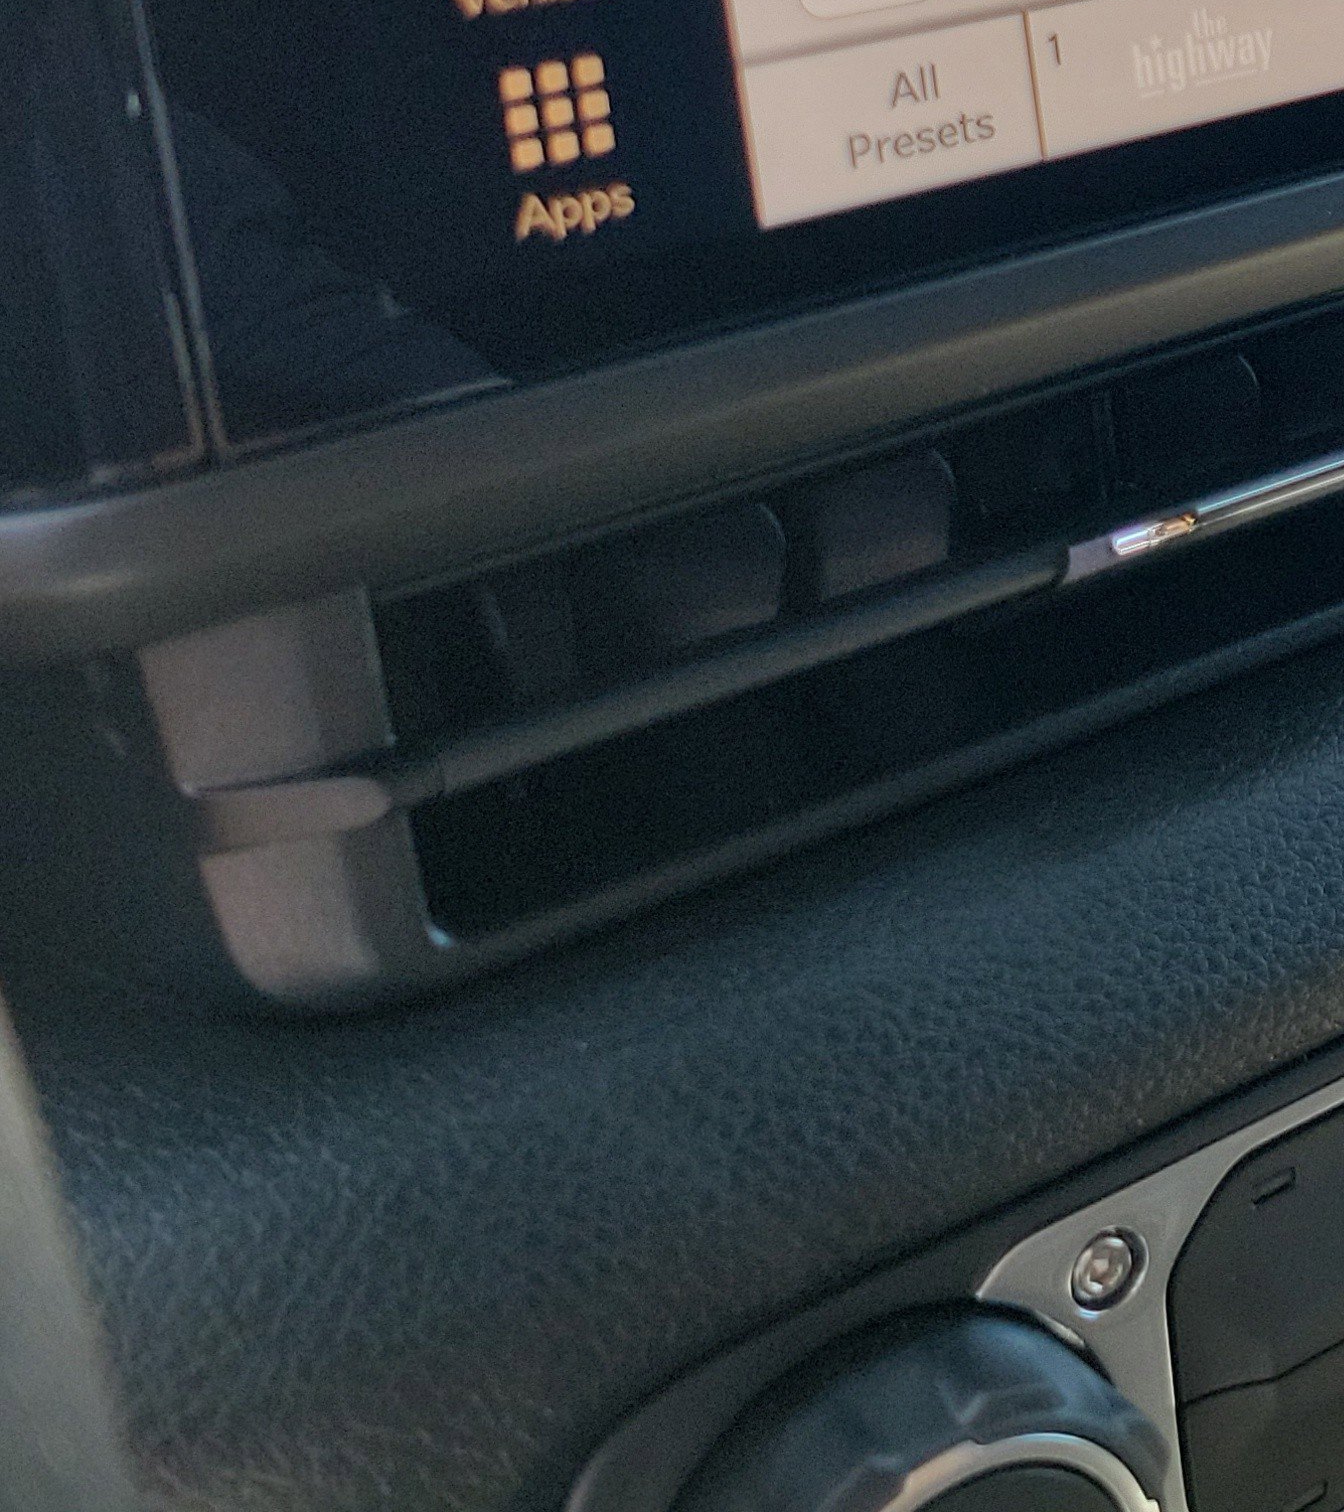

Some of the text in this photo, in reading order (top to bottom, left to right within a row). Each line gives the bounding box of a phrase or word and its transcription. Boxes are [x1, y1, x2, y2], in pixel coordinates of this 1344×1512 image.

[1048, 33, 1062, 66] 1
[1132, 26, 1273, 94] highway
[891, 62, 940, 109] All
[848, 109, 996, 170] Presets
[514, 180, 637, 241] Apps
